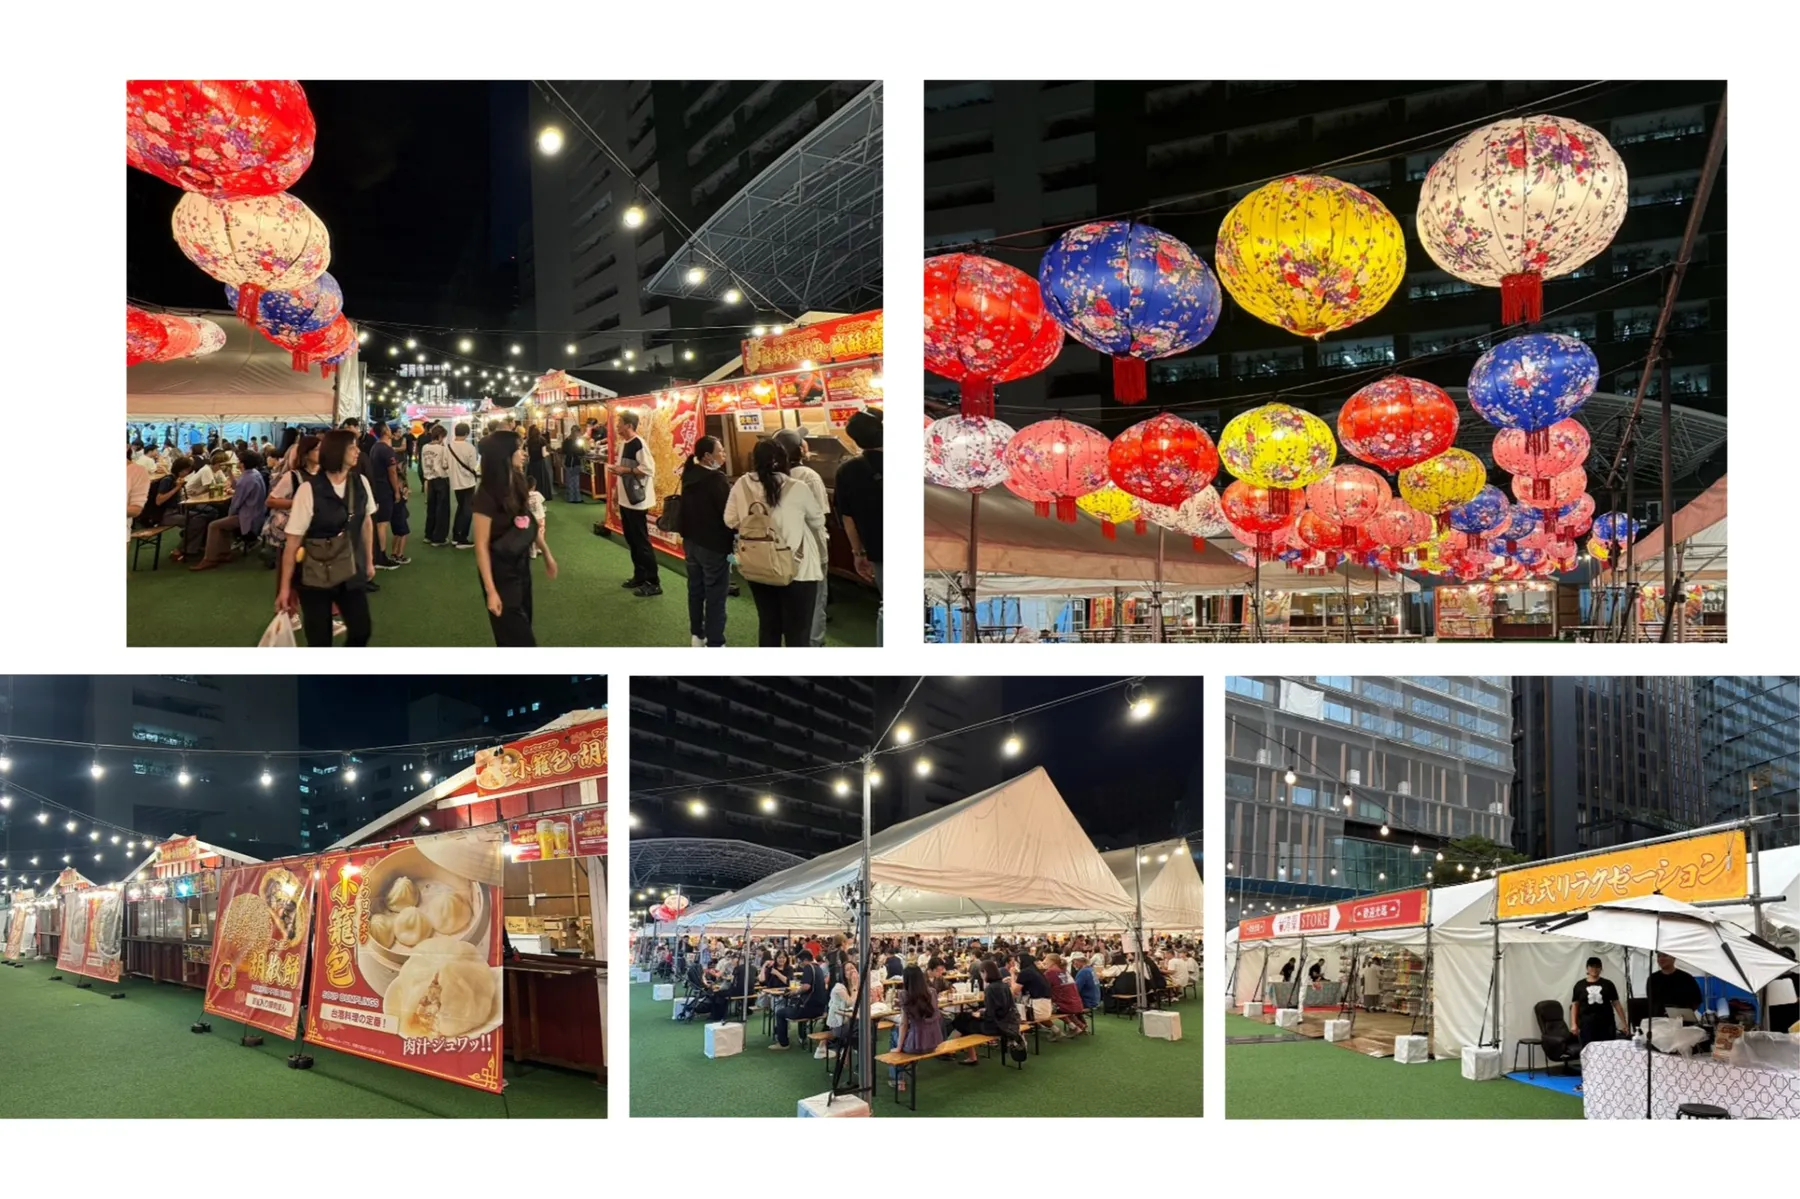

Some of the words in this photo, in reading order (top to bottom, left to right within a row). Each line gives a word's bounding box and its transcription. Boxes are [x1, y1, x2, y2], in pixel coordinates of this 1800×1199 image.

[1504, 853, 1728, 907] 台湾式リラクゼーション
[327, 867, 357, 987] 小籠包
[1301, 912, 1328, 929] STORE
[322, 990, 339, 1000] SOUP
[340, 993, 379, 1008] DUMPLINGS
